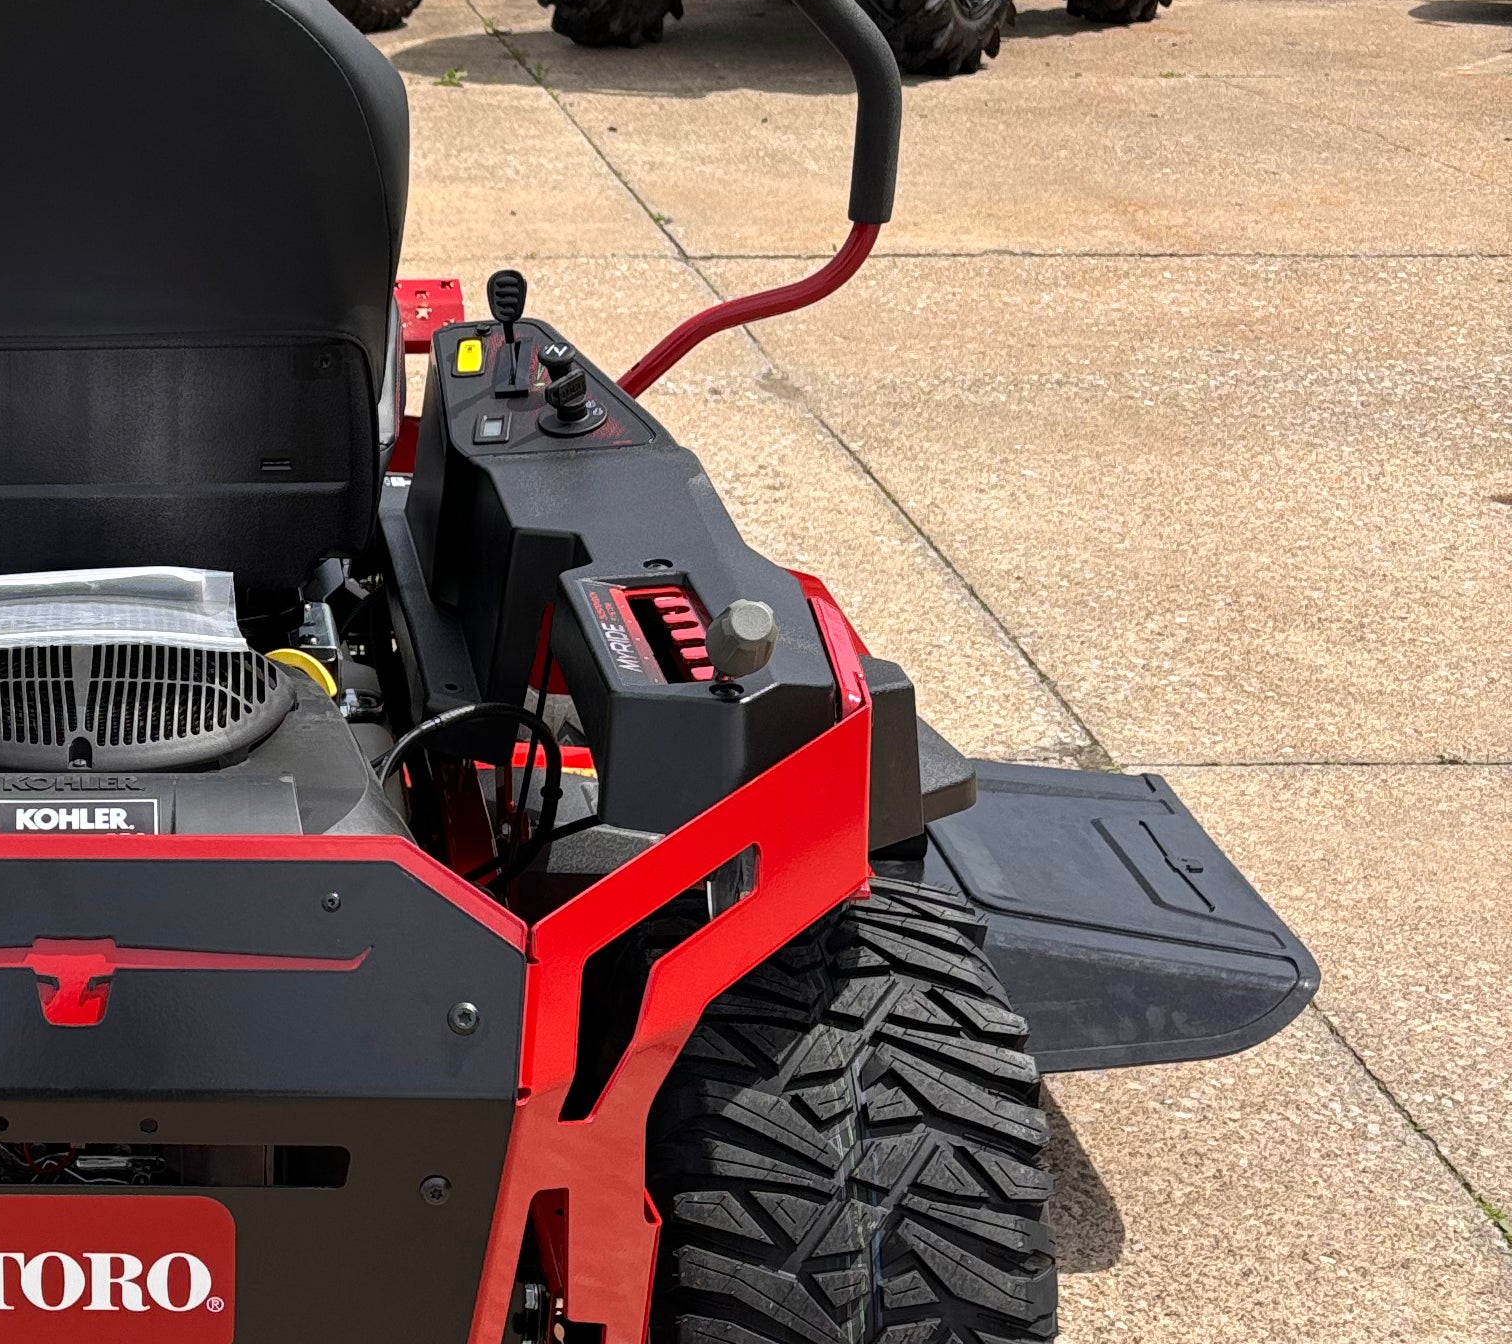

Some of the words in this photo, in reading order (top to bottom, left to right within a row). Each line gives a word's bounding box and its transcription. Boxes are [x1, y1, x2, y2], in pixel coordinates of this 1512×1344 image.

[600, 622, 644, 673] MYRIDE
[2, 775, 146, 792] KOHLER
[15, 807, 135, 831] KOHLER
